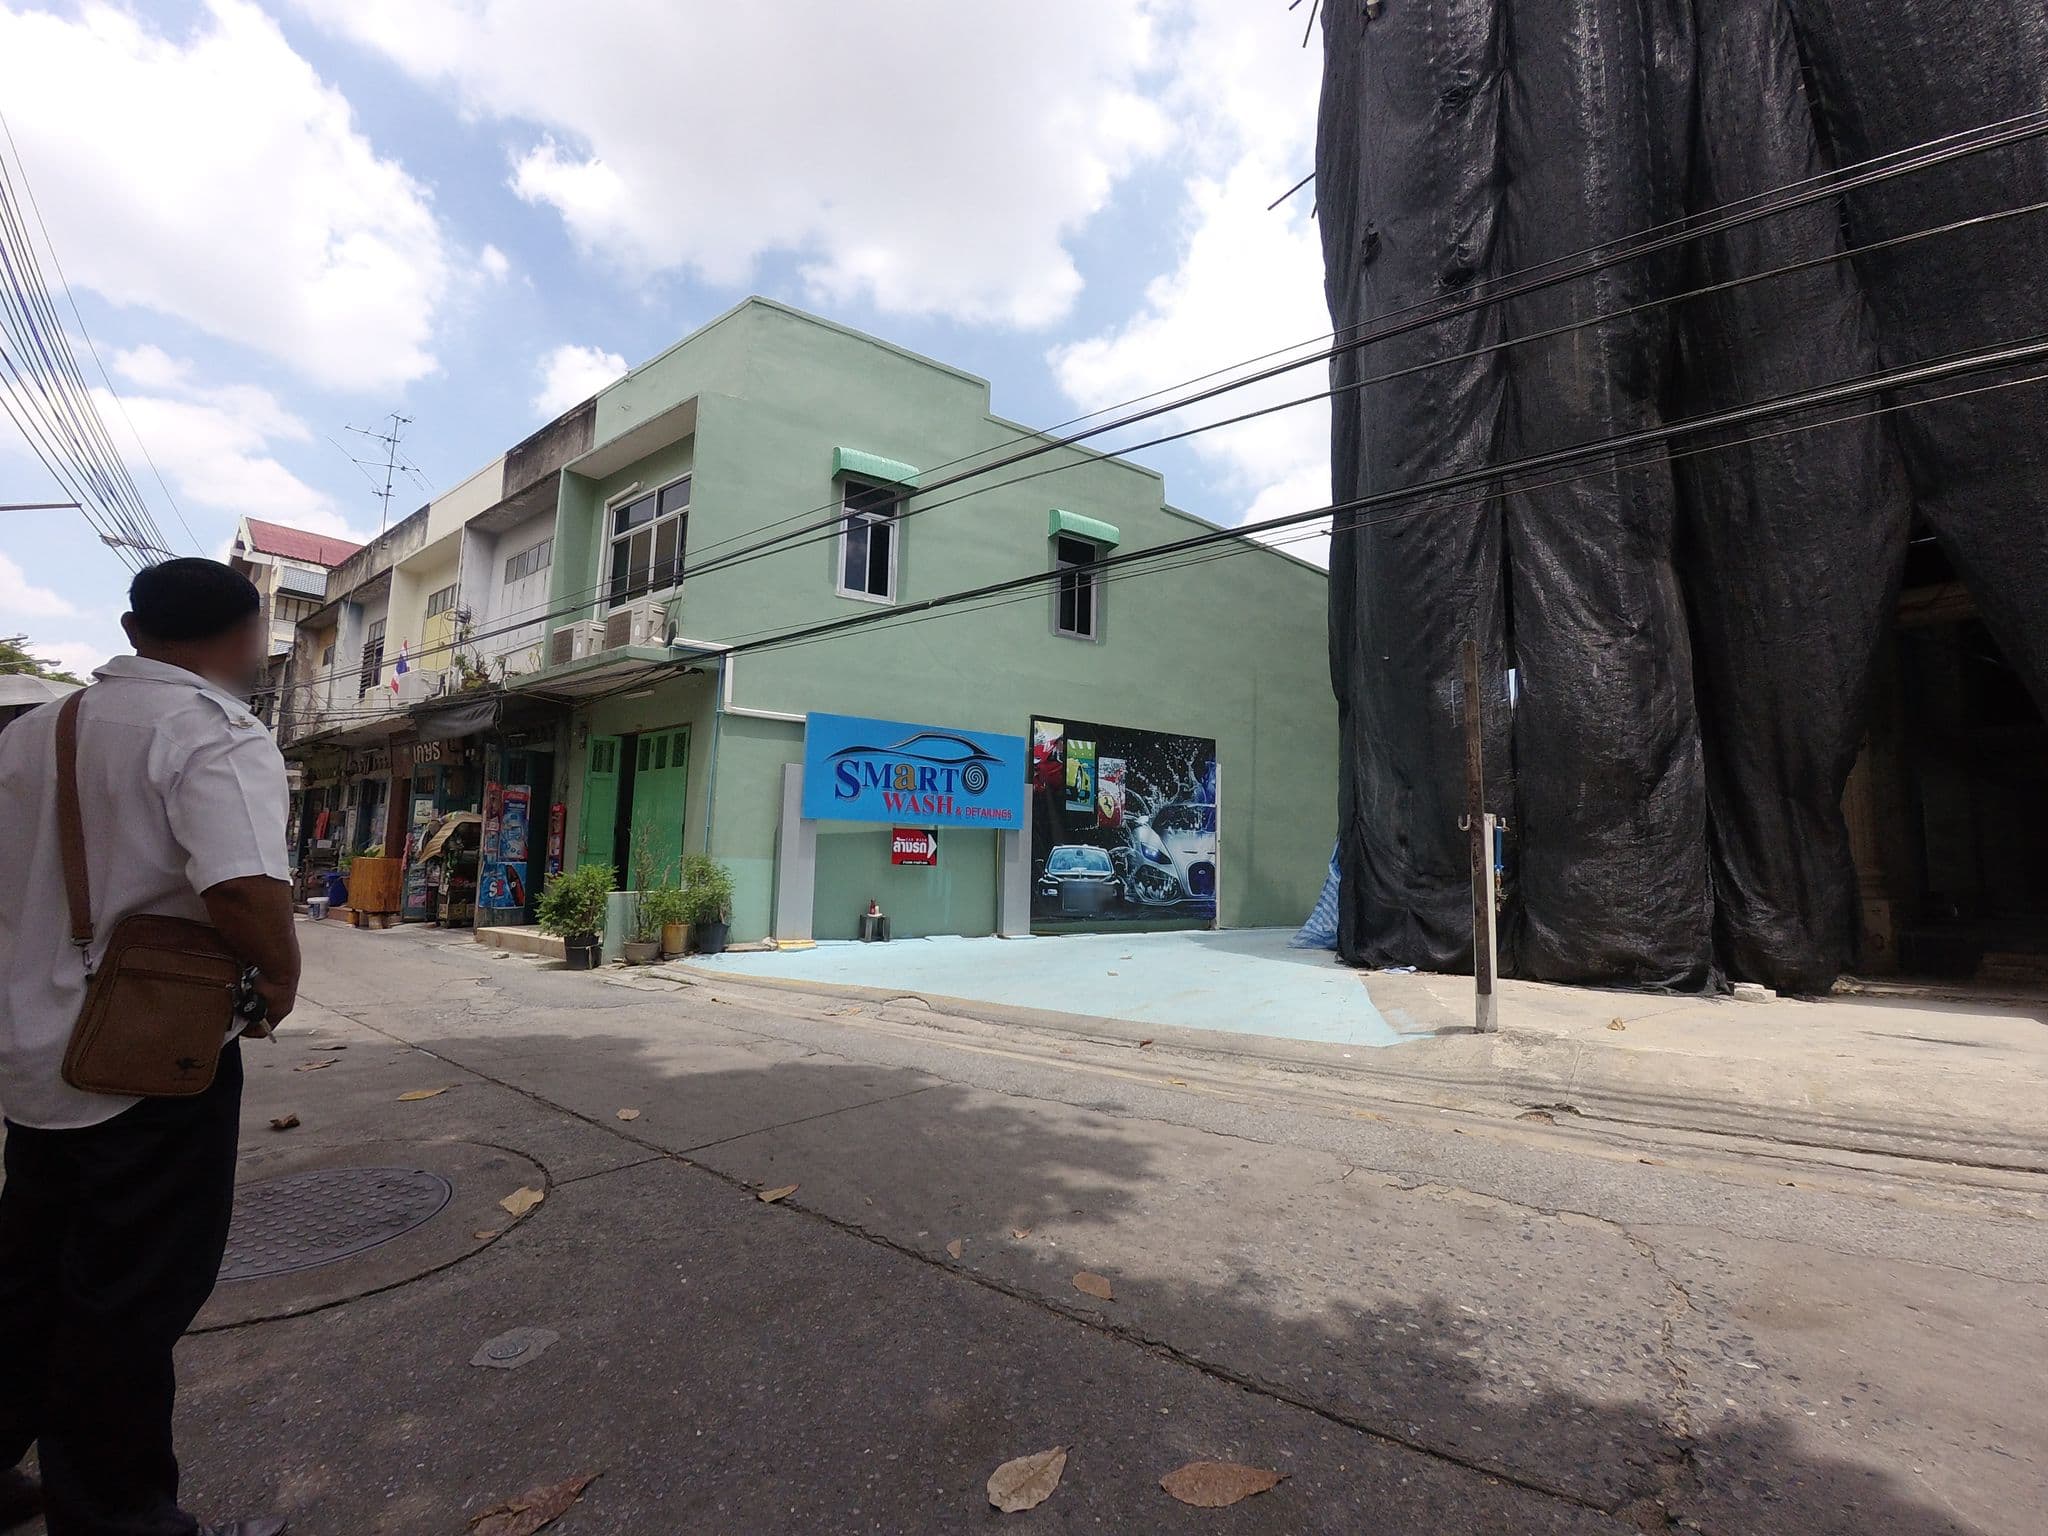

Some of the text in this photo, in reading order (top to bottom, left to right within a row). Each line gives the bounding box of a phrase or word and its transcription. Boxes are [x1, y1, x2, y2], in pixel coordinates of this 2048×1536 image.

[882, 791, 954, 816] WASH
[955, 806, 963, 816] &
[893, 837, 927, 853] ล้างรถ
